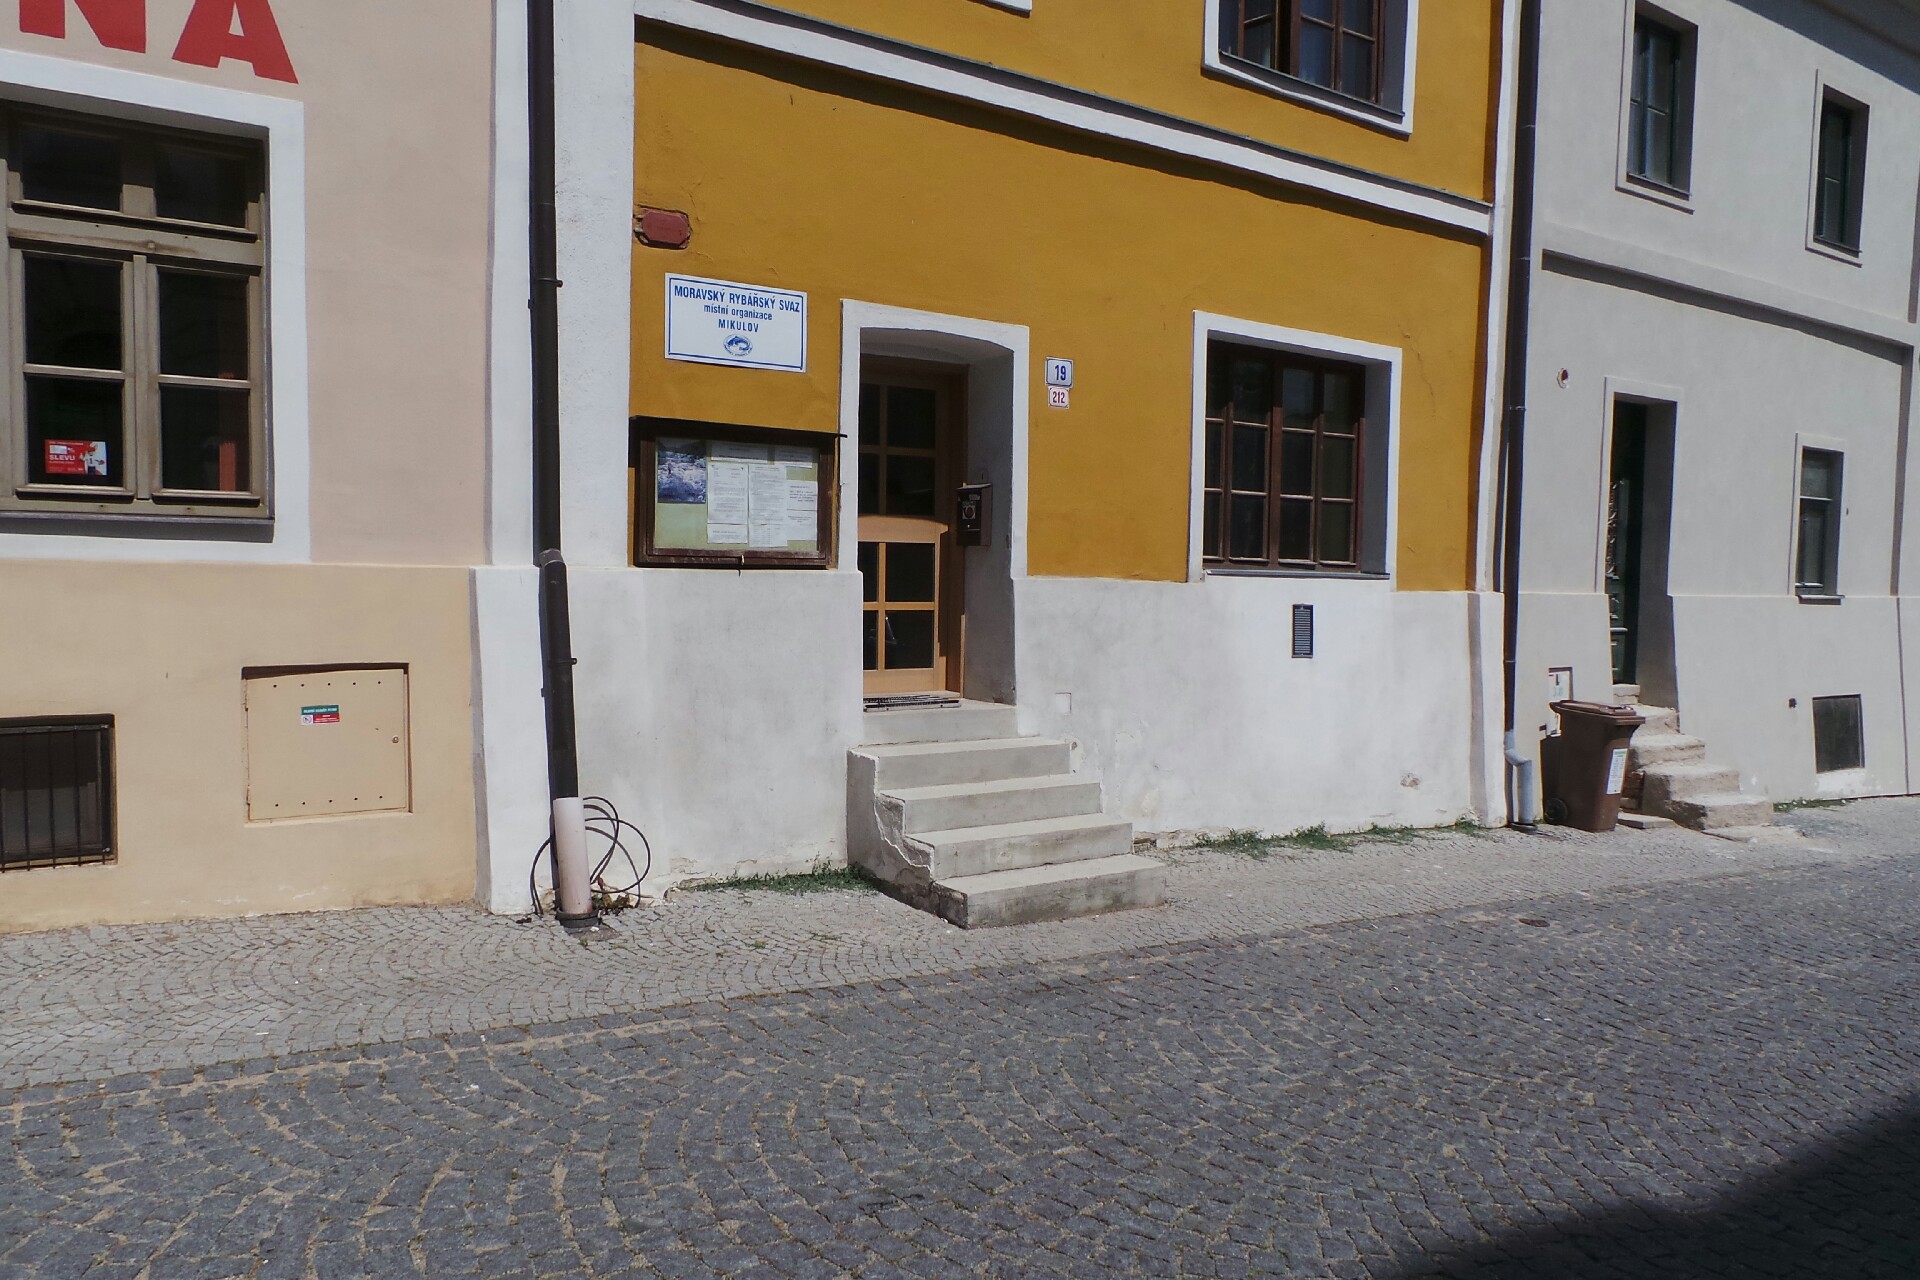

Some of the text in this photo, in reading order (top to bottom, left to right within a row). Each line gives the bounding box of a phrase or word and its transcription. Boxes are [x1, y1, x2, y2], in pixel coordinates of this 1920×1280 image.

[674, 285, 800, 312] MORAVSKÝ RYBÁŘSKÝ SVAZ
[703, 303, 772, 320] místní organizace
[718, 318, 759, 333] MIKULOV
[1054, 364, 1067, 381] 19
[1052, 391, 1066, 404] 212
